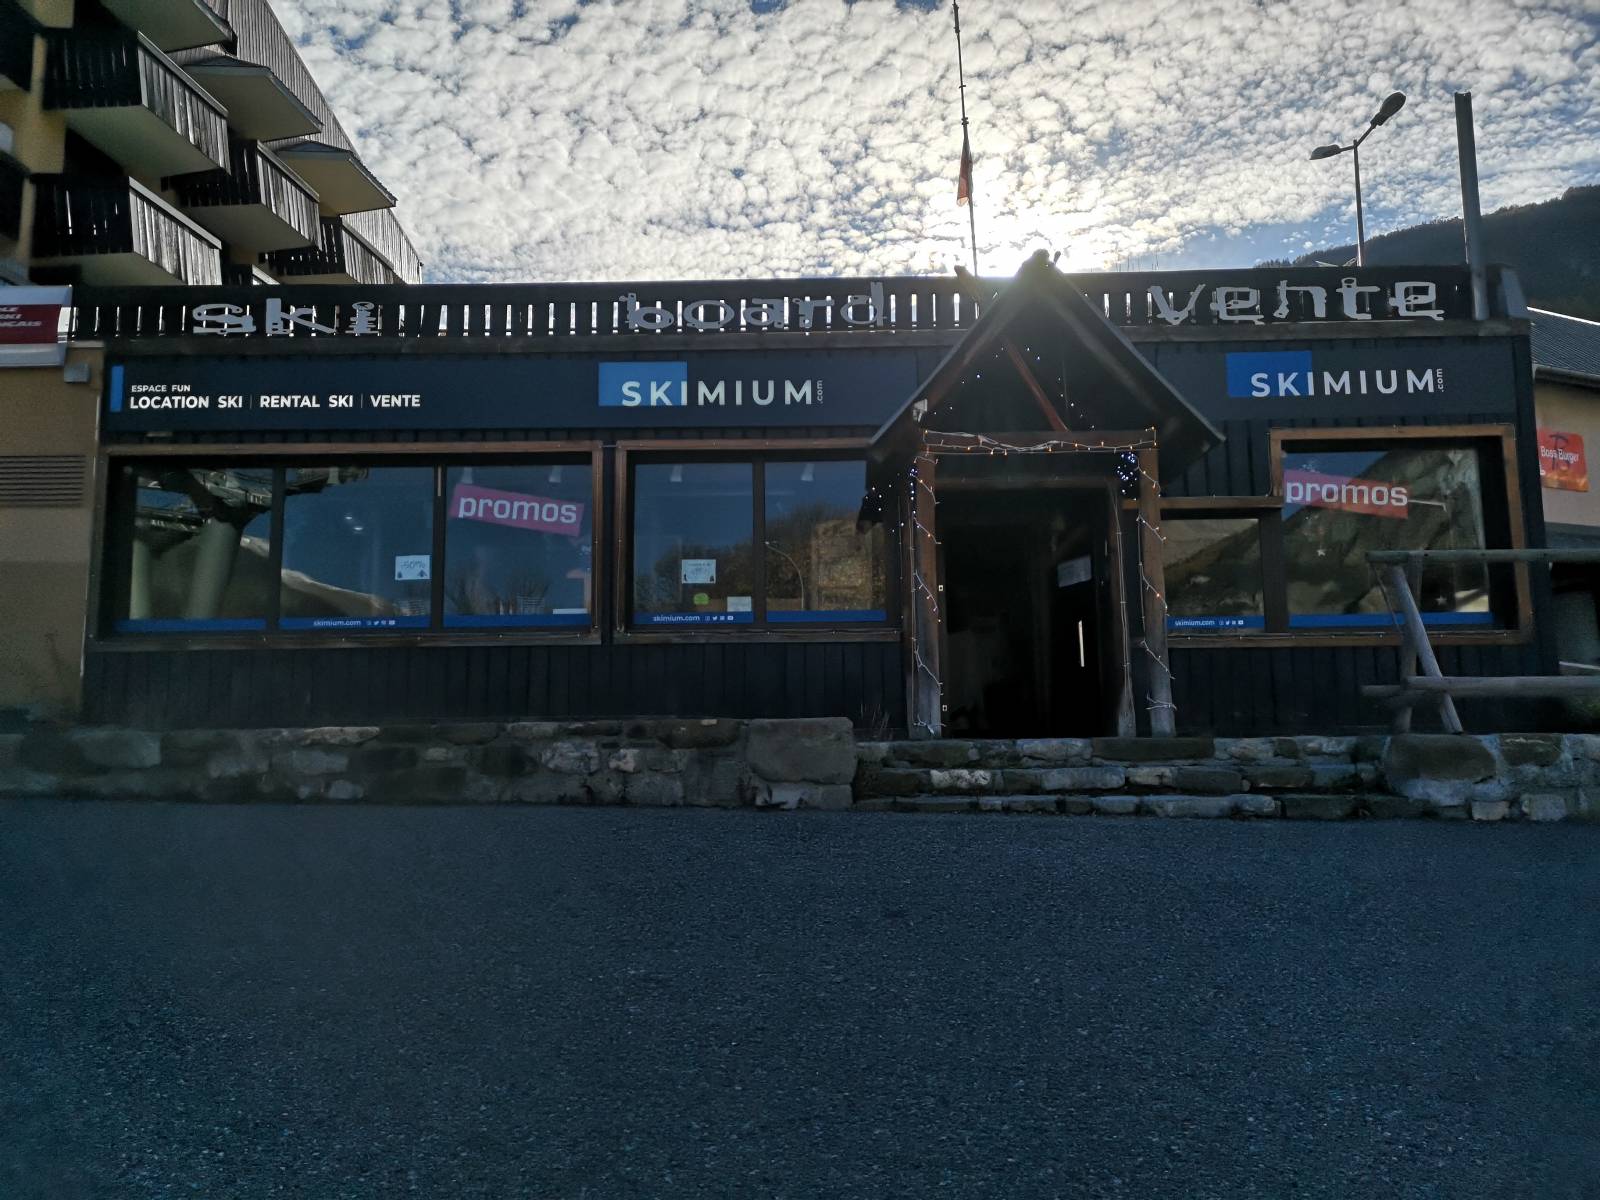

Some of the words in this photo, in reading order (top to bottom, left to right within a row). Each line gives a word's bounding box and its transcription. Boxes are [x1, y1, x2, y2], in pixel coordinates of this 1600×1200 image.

[619, 281, 886, 330] board
[1148, 277, 1446, 326] vente
[131, 384, 167, 392] ESPACE
[172, 384, 191, 392] FUN
[621, 379, 812, 407] SKIMIUM
[816, 380, 824, 405] .com
[1251, 368, 1435, 398] SKIMIUM
[1436, 368, 1444, 393] .com
[130, 395, 210, 409] LOCATION
[218, 395, 243, 409] SKI
[260, 394, 320, 408] RENTAL
[328, 394, 353, 408] SKI
[370, 394, 421, 408] VENTE
[1286, 481, 1408, 506] promos
[458, 496, 577, 524] promos
[313, 619, 361, 627] skimium.com
[653, 614, 701, 622] skimium.com
[1175, 619, 1215, 627] skimium.com
